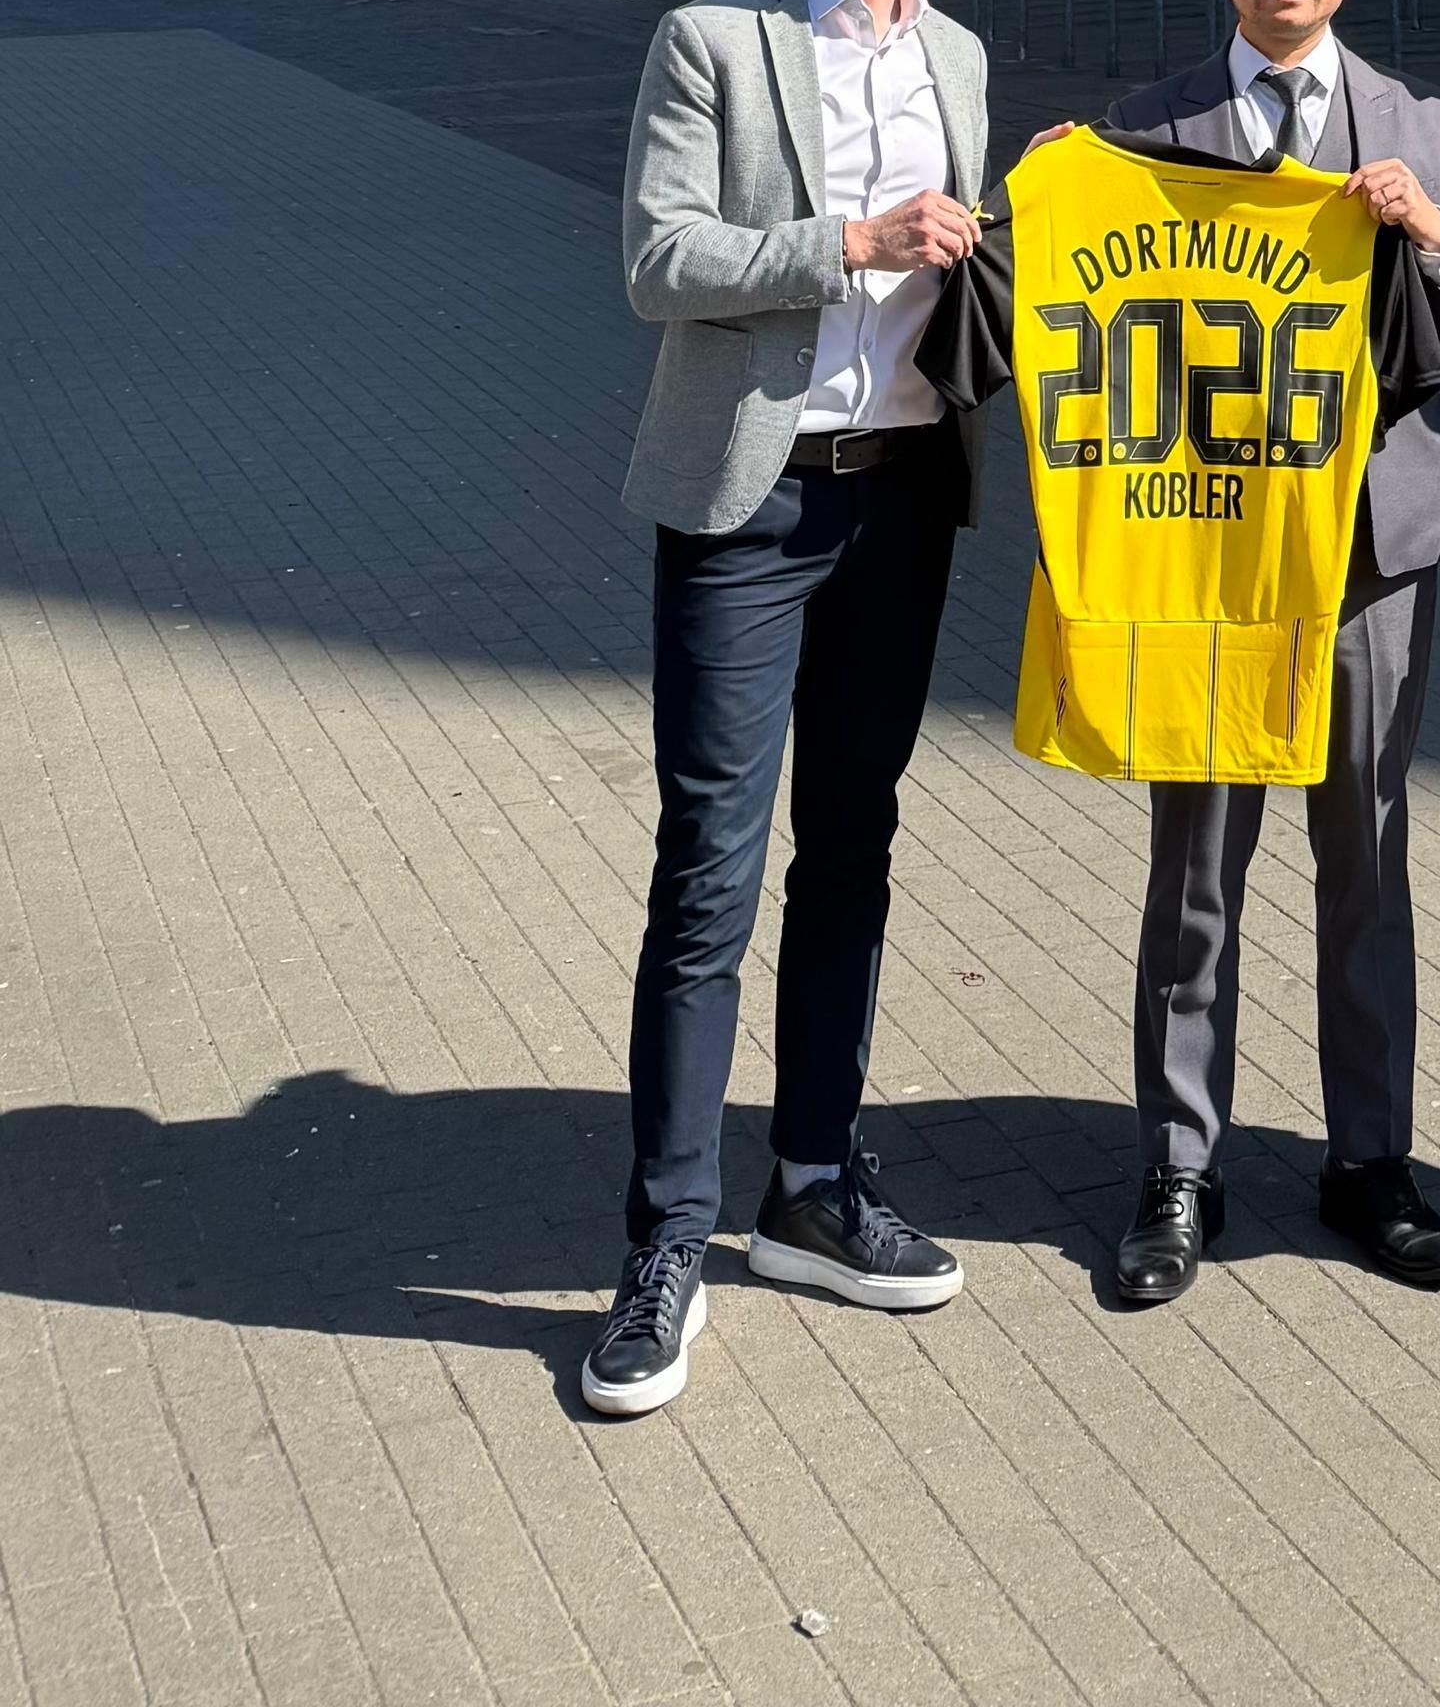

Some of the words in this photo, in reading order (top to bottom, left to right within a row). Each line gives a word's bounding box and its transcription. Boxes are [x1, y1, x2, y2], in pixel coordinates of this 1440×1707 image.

[1071, 220, 1314, 296] DORTMUND
[1033, 298, 1345, 470] 2026
[1124, 471, 1245, 522] KOBLER
